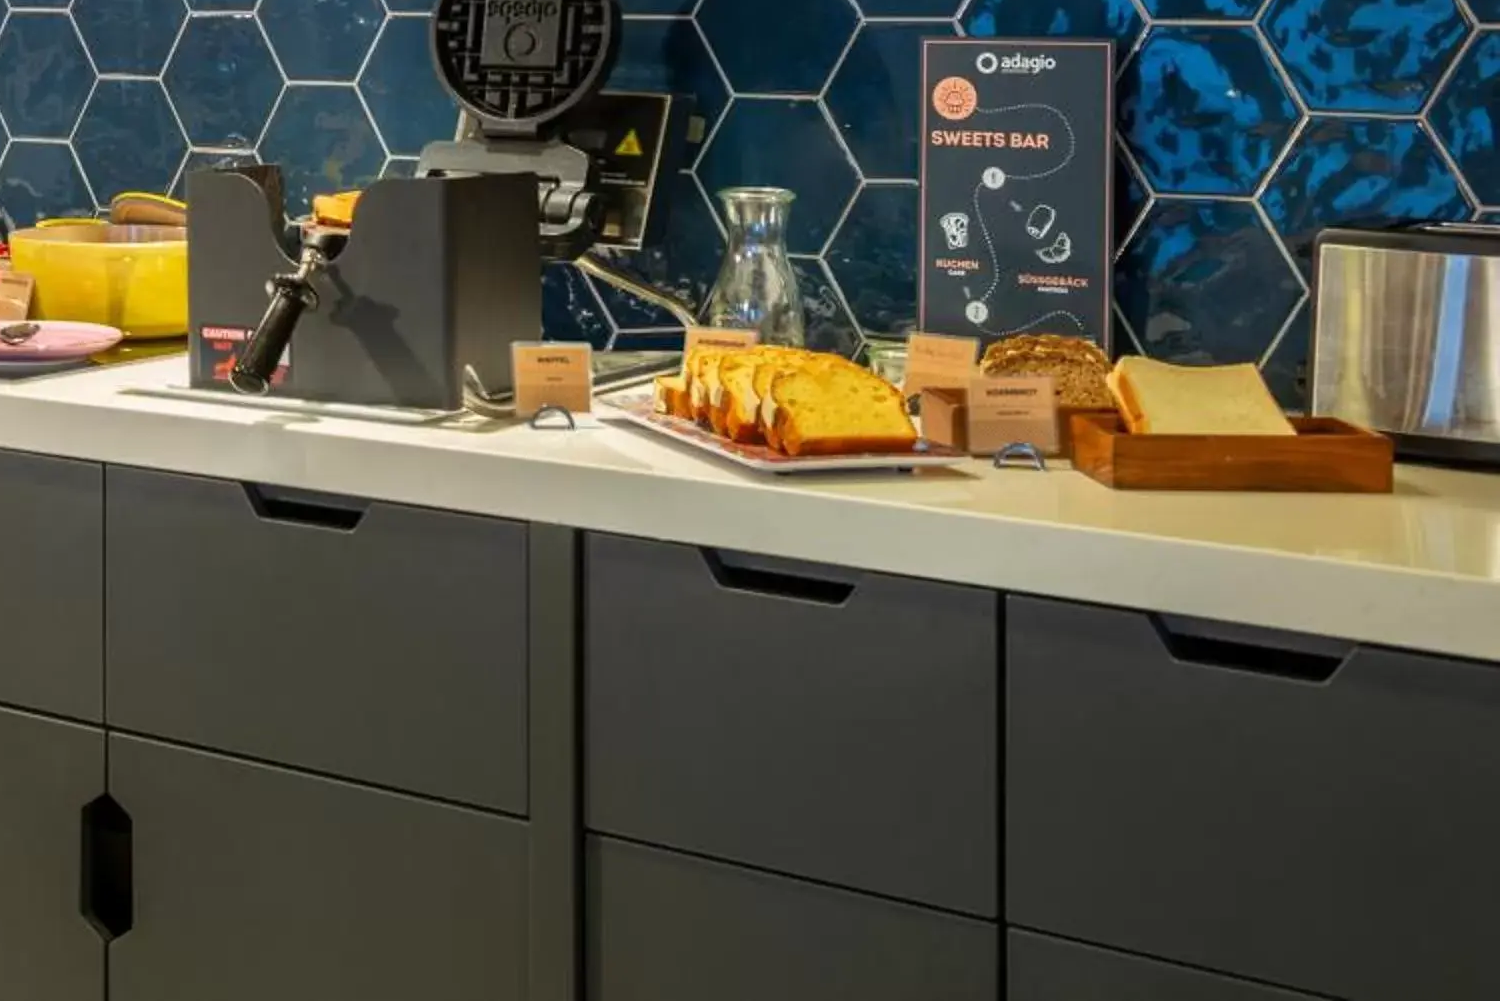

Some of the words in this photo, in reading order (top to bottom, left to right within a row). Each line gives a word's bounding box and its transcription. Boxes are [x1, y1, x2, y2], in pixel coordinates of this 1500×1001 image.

[1001, 52, 1057, 75] adagio
[931, 130, 1005, 148] SWEETS
[1009, 132, 1050, 149] BAR
[935, 257, 979, 271] KUCHEN
